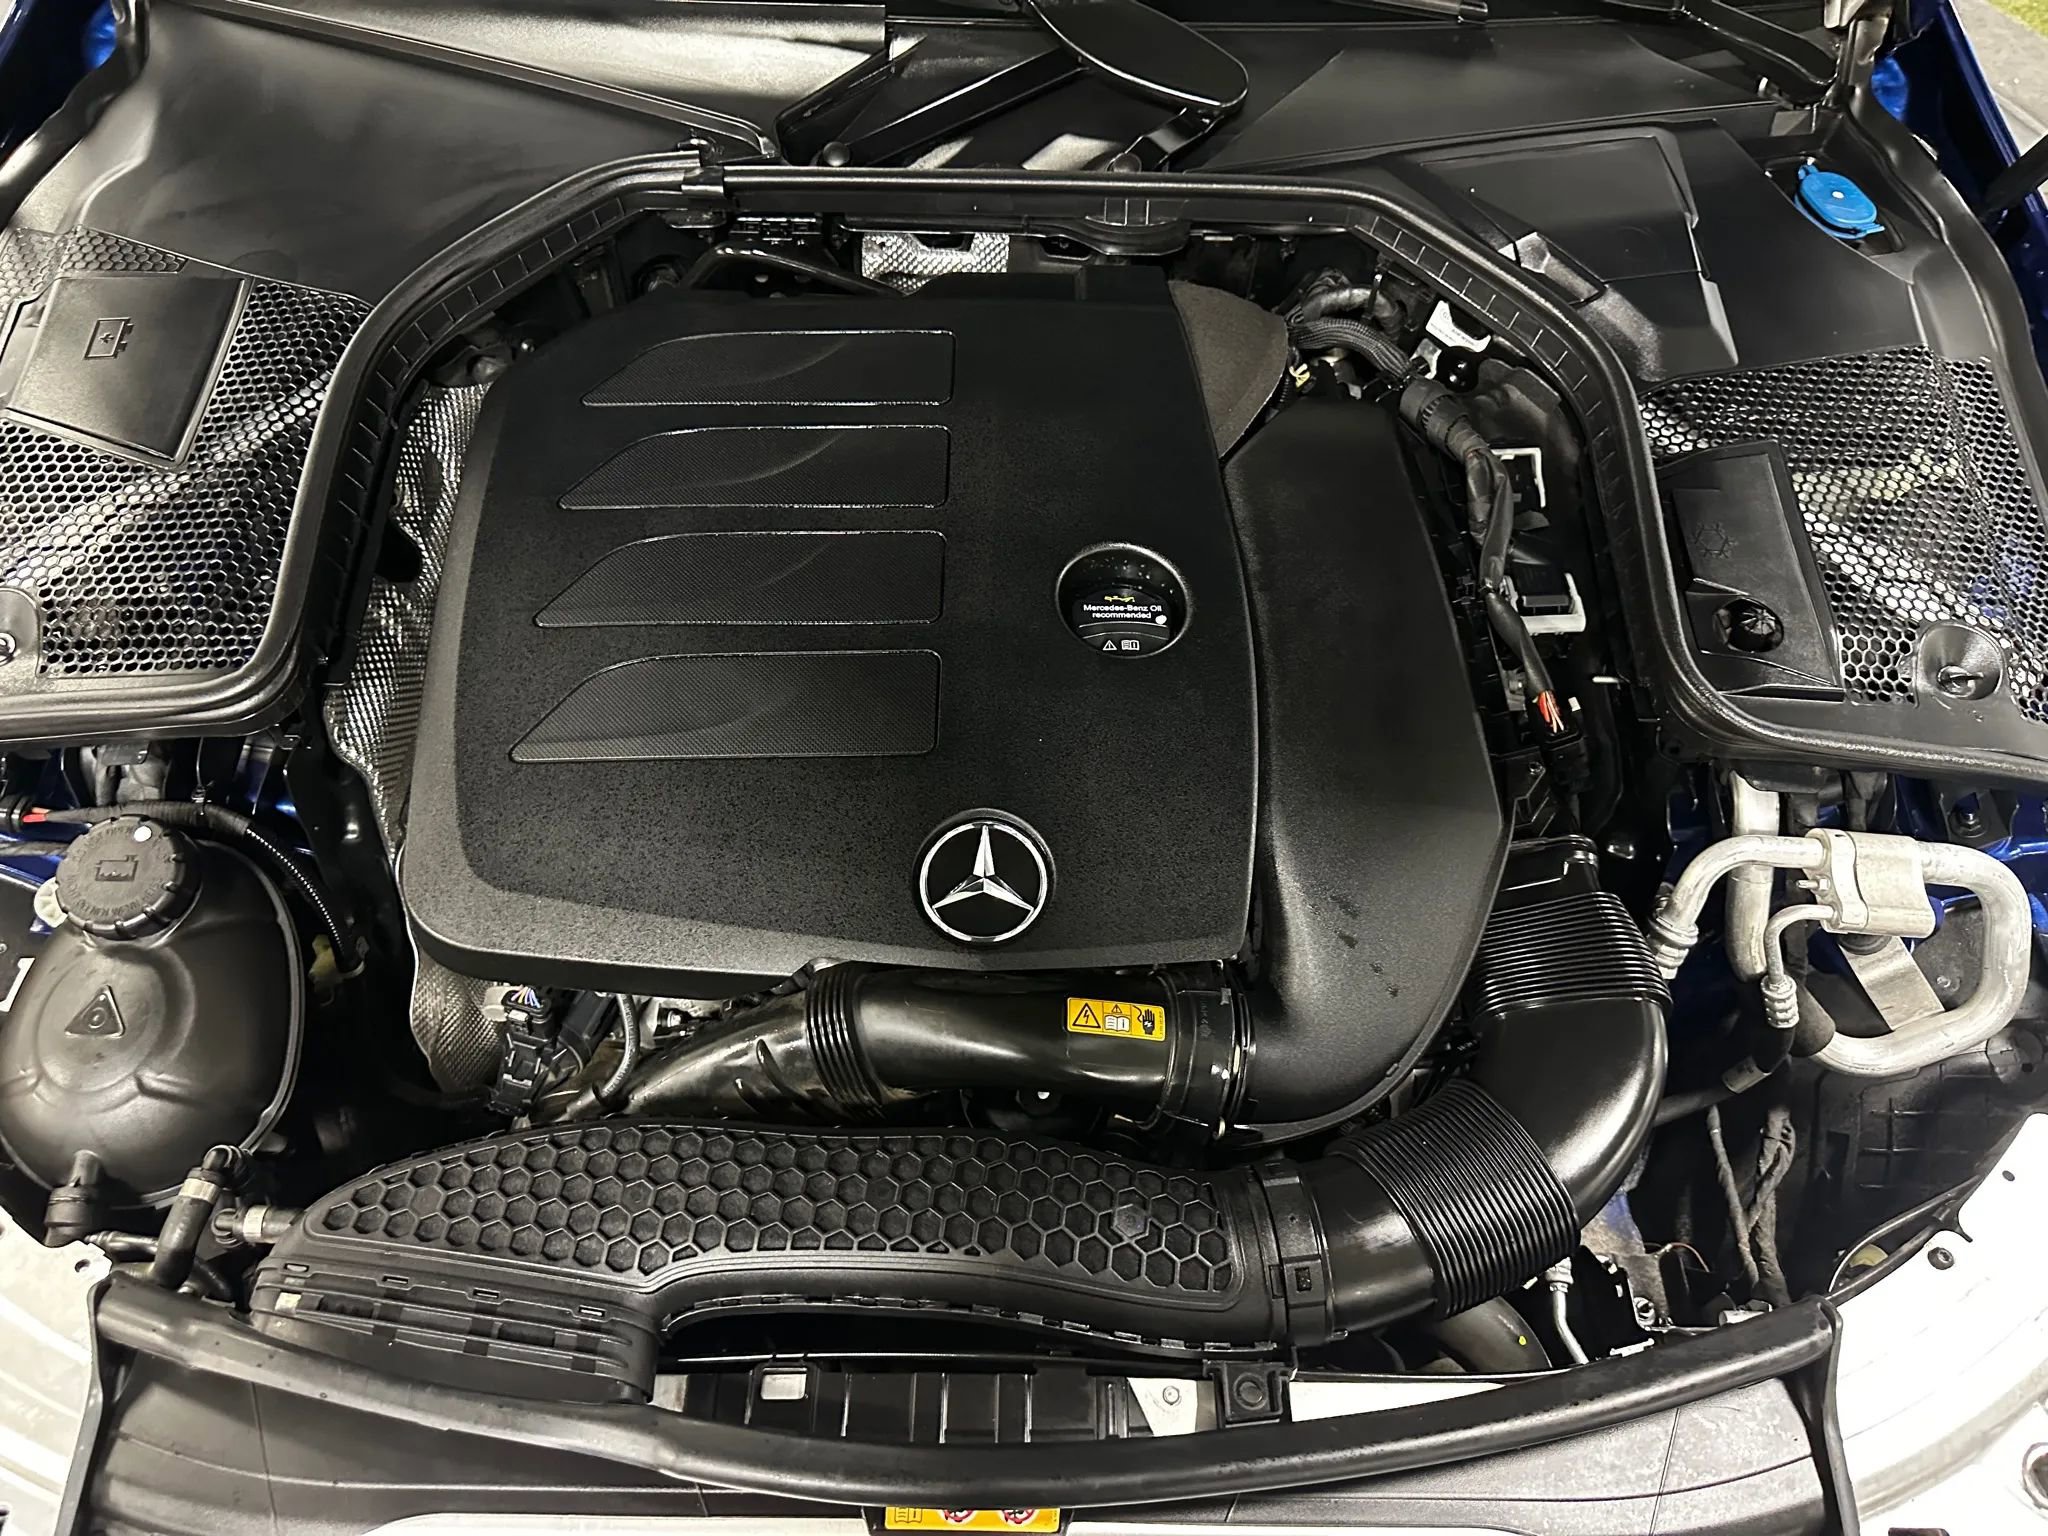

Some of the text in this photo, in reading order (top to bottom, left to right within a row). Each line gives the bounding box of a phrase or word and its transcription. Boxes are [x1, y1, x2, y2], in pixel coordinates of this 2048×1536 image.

[1083, 604, 1162, 612] Mercedes-Benz Oil
[1092, 611, 1152, 619] recommended
